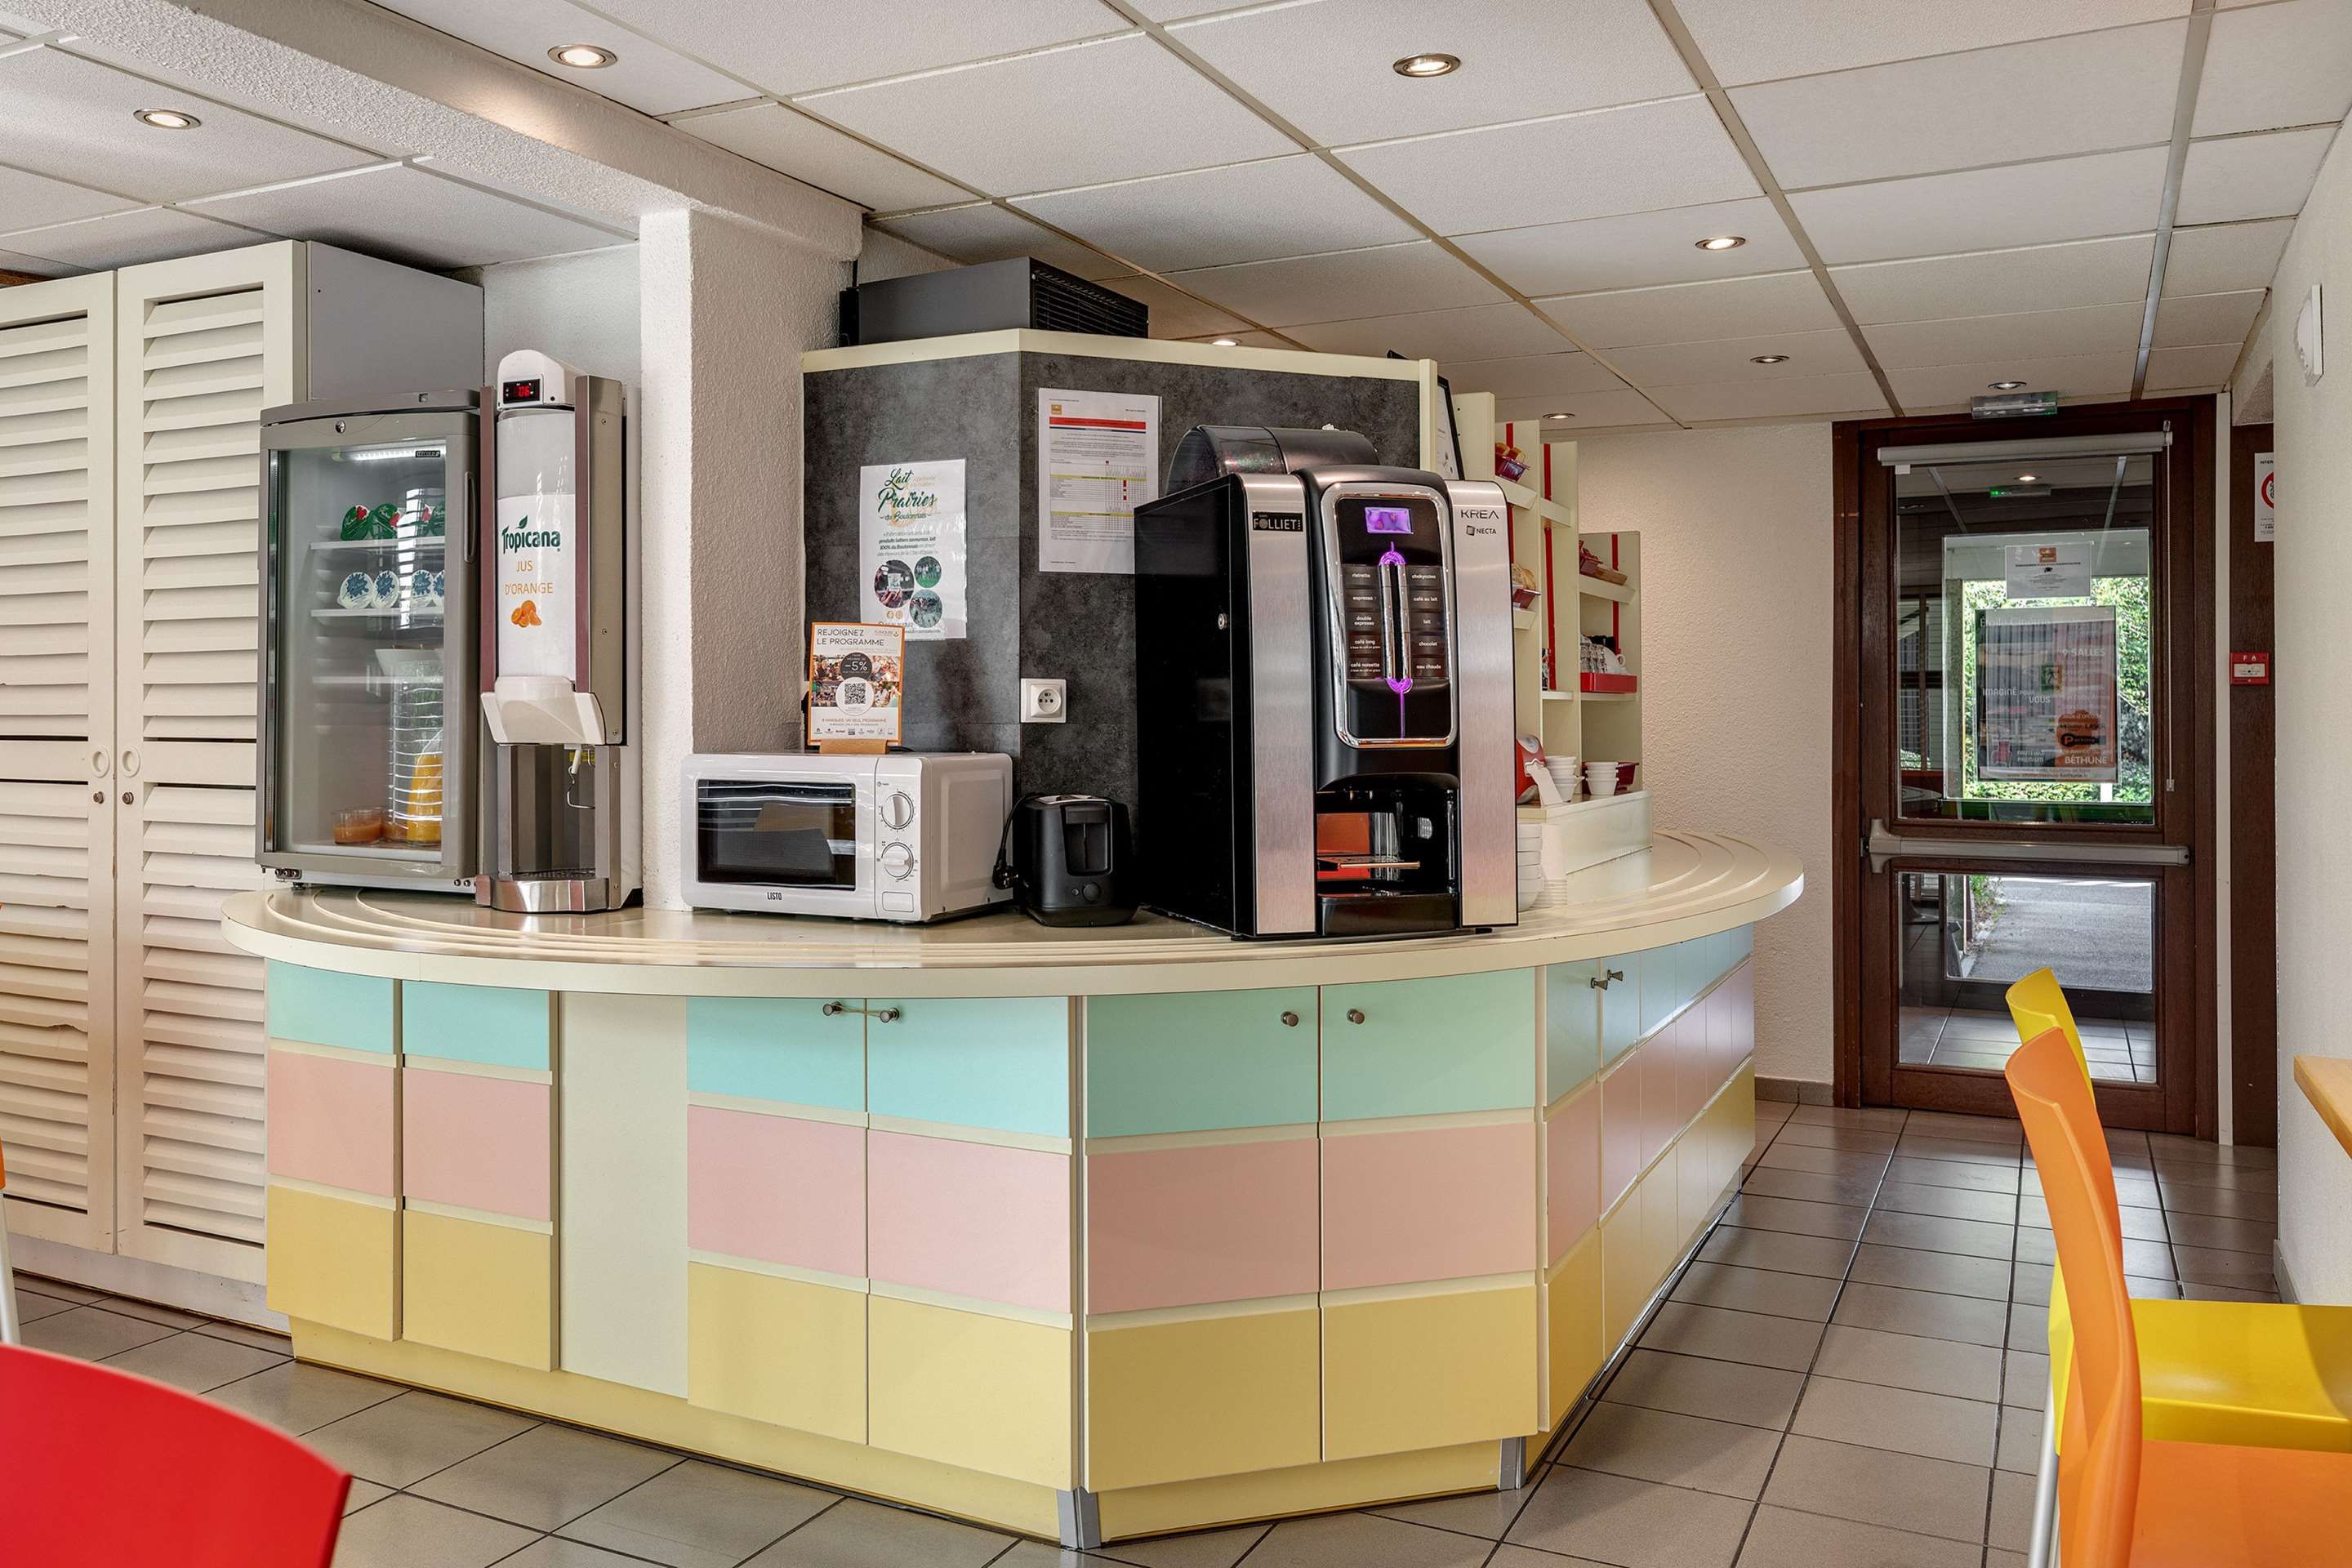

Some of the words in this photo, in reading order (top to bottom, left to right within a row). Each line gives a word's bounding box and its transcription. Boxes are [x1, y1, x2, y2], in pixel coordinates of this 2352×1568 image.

[884, 468, 914, 490] Lait
[878, 488, 938, 513] Prairies
[1254, 518, 1297, 530] FOLLIET
[501, 525, 561, 555] Tropicana
[516, 560, 533, 572] JUS
[505, 582, 554, 595] D'ORANGE
[817, 628, 865, 637] REJOIGNEZ
[829, 638, 885, 646] PROGRAMME
[845, 661, 868, 671] -5%
[2029, 695, 2051, 704] VOUS
[2065, 755, 2108, 764] BÉTHUNE
[767, 892, 782, 901] LISTO
